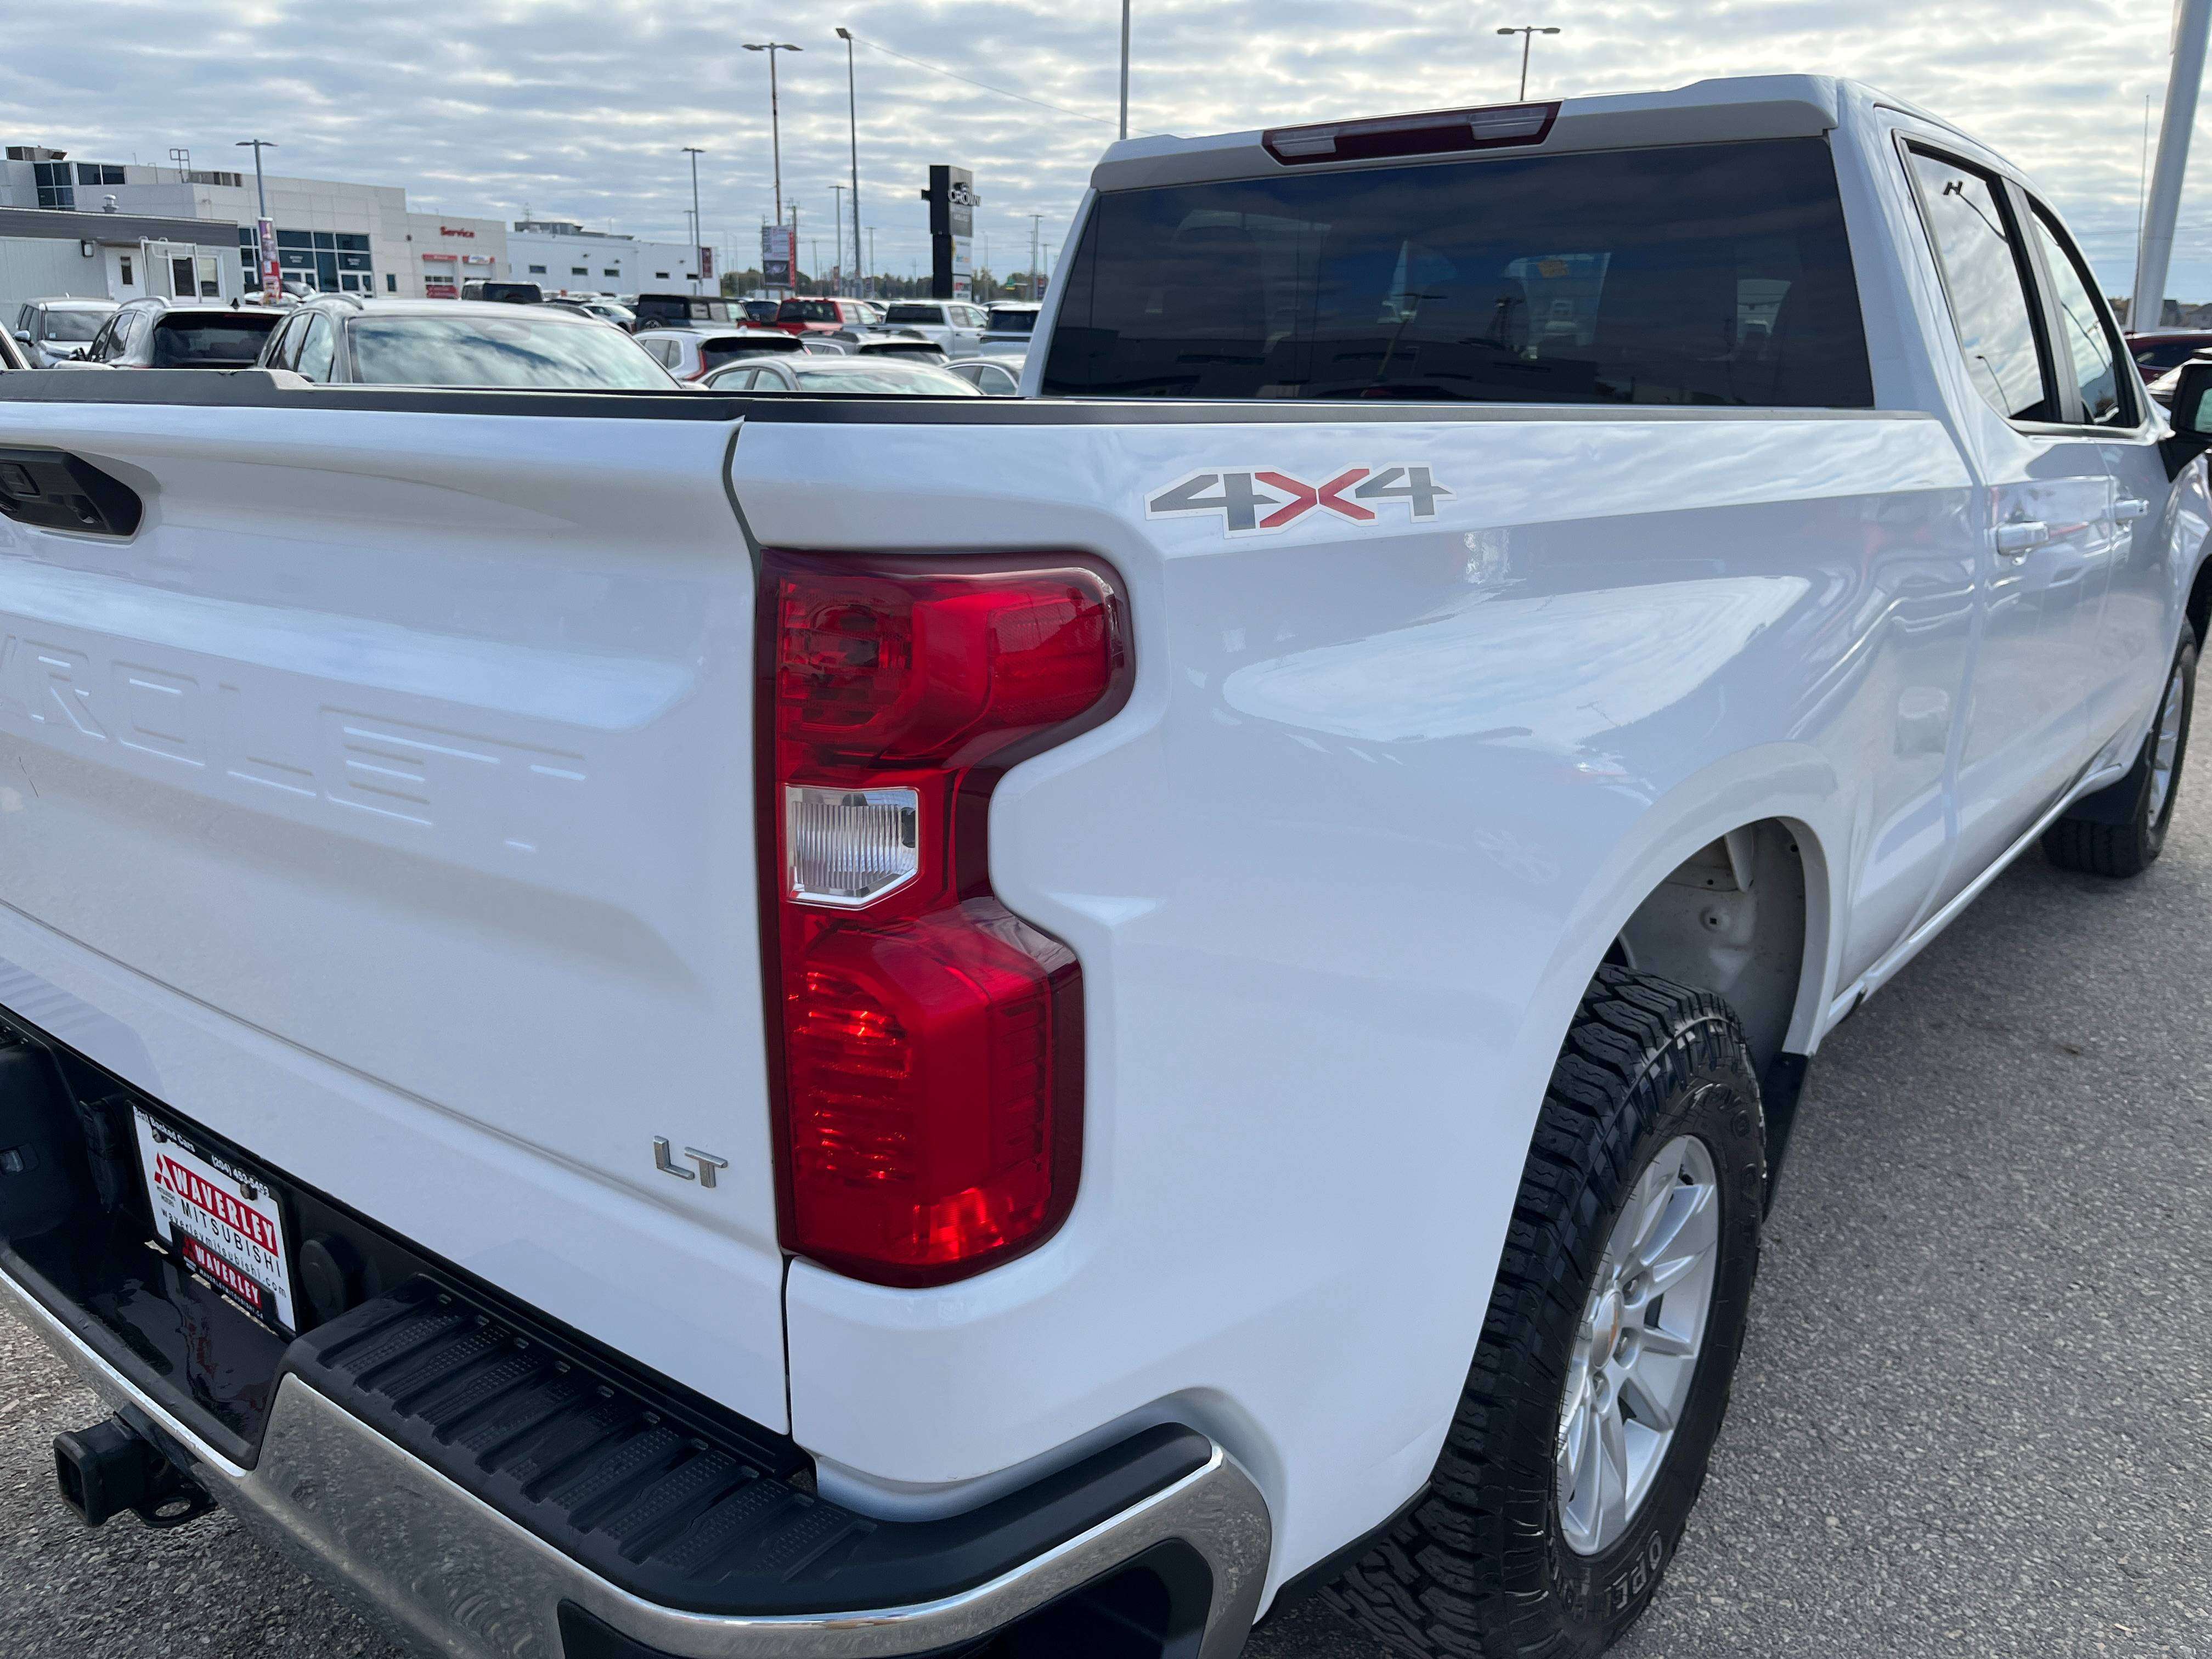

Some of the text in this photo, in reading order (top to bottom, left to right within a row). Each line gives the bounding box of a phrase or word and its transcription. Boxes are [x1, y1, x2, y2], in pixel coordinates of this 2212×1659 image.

[948, 189, 981, 207] CROWN
[440, 225, 475, 238] Service
[0, 635, 586, 851] ROLET
[653, 1135, 729, 1189] LT
[173, 1164, 274, 1250] WAVERLEY
[180, 1198, 281, 1278] MITSUBISHI
[194, 1244, 259, 1304] WAVERLEY
